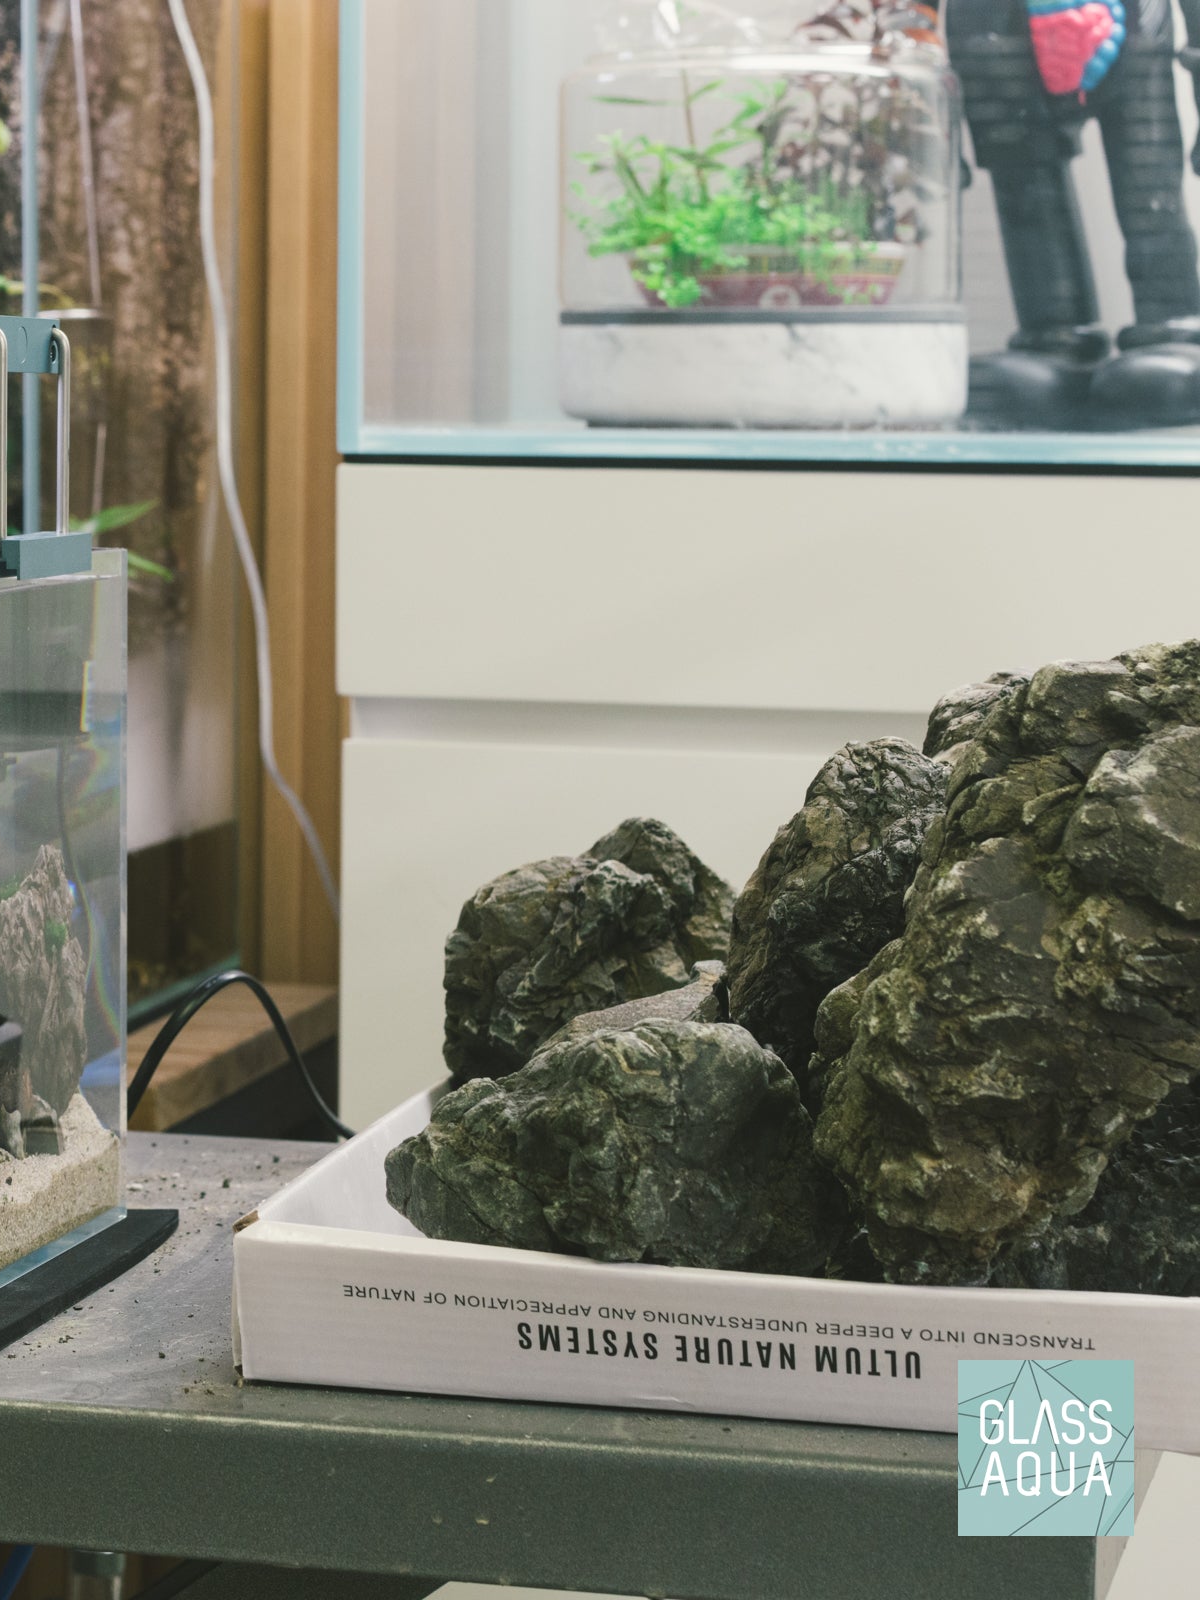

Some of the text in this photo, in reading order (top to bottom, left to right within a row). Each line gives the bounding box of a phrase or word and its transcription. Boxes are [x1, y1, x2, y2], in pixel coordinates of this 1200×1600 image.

[343, 1284, 1096, 1351] TRANSCEND INTO A DEEPER UNDERSTANDING AND APPRECIATION OF NATURE
[517, 1321, 921, 1379] ULTUM NATURE SYSTEMS
